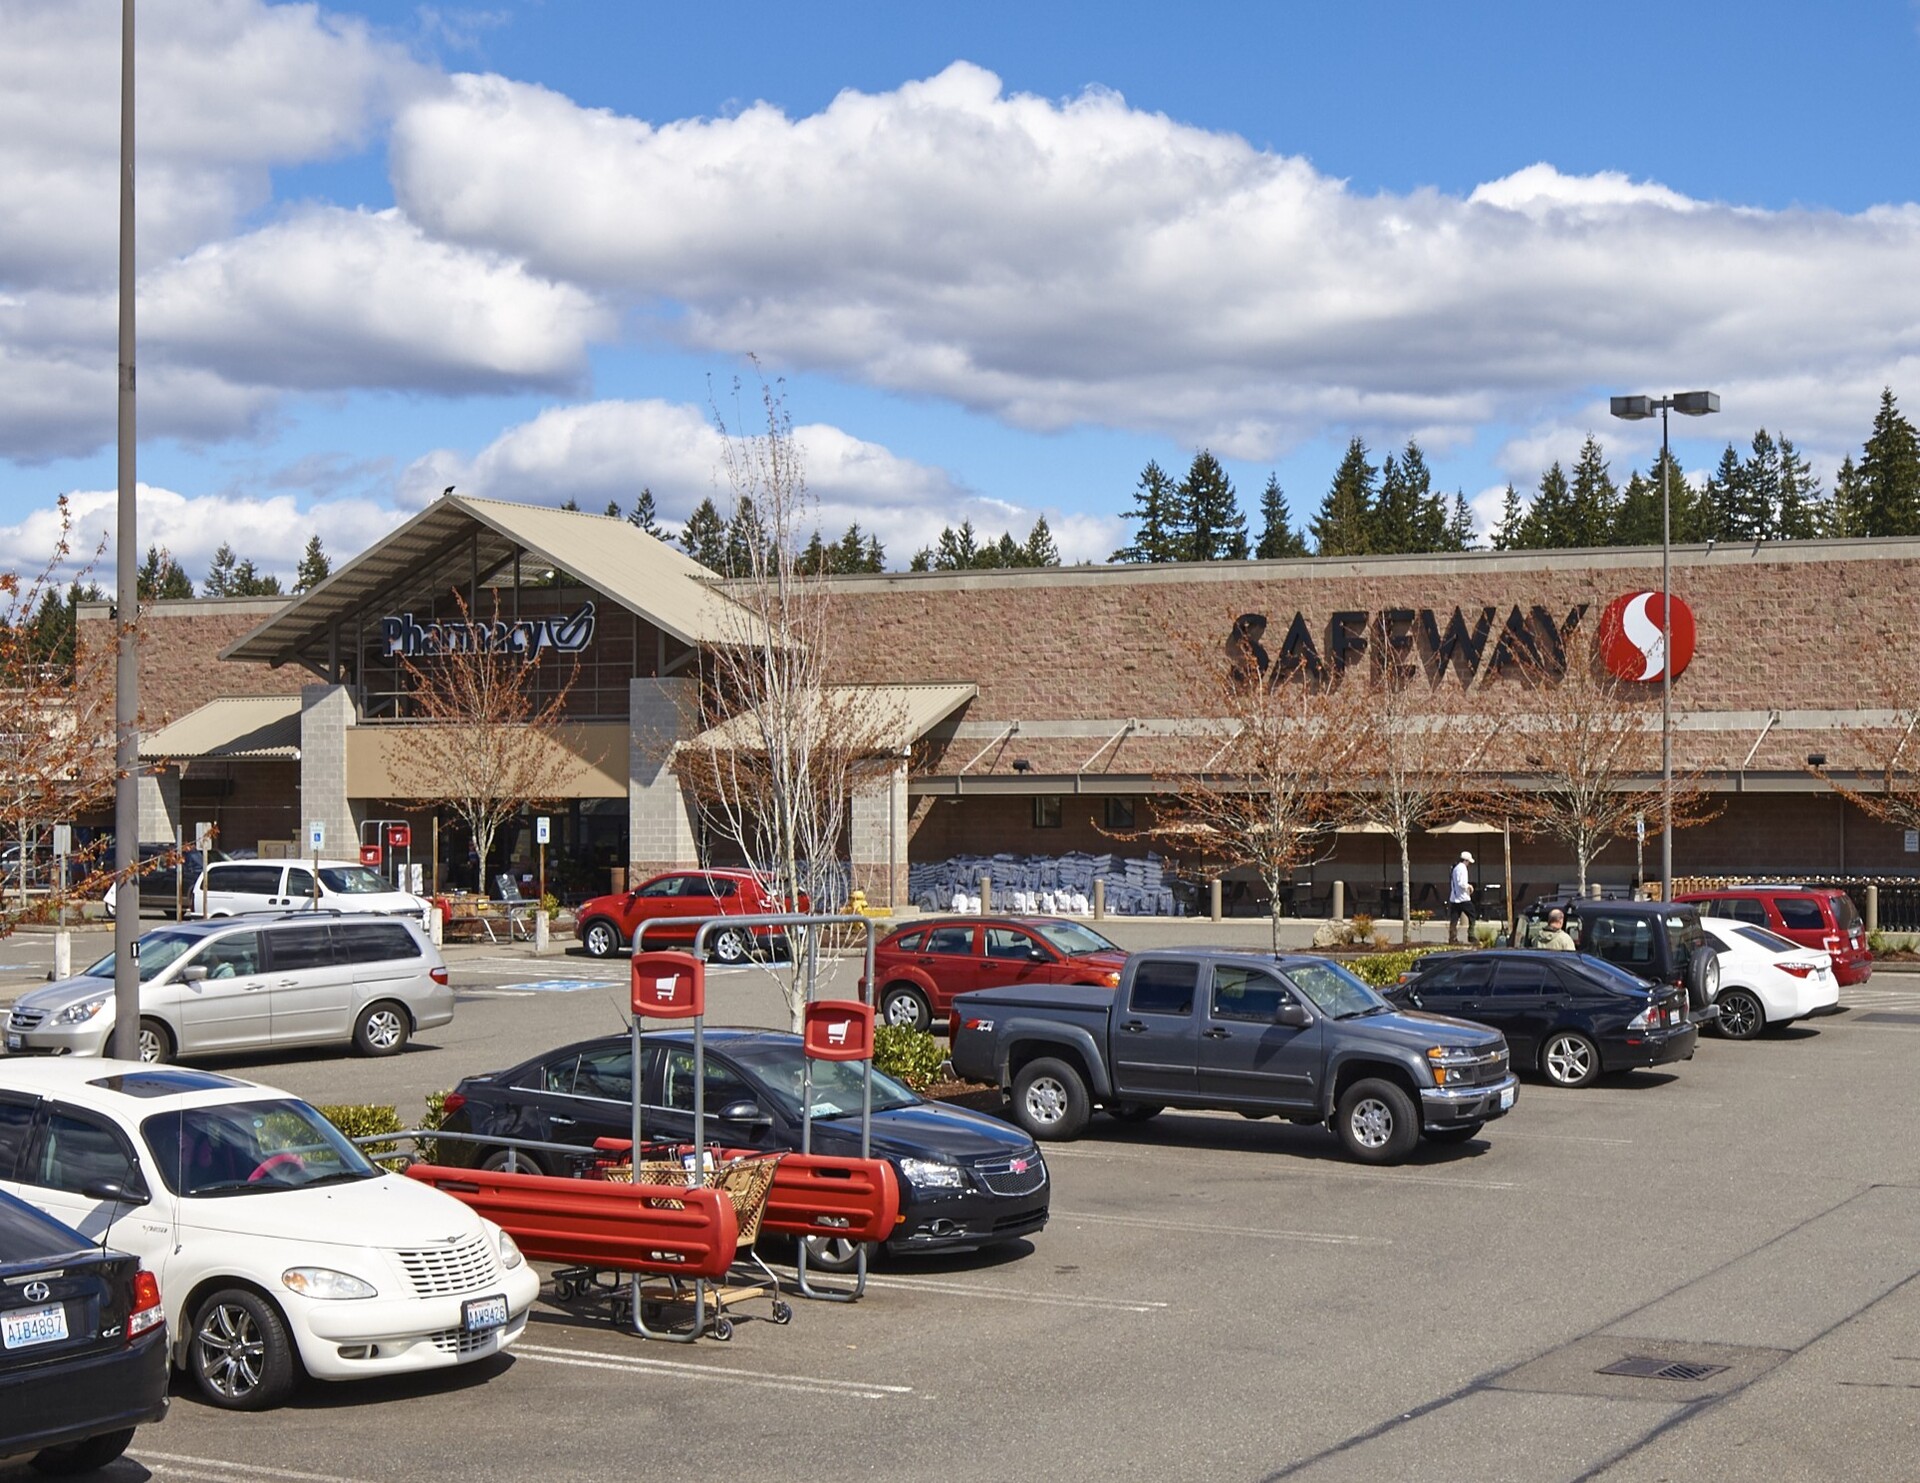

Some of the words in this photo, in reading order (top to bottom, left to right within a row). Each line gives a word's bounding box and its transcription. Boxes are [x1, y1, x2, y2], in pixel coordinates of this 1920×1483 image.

[382, 613, 549, 665] Pharmacy
[1230, 603, 1590, 687] SAFEWAY
[8, 1315, 62, 1342] AIB4897
[469, 1305, 505, 1327] AAW9426
